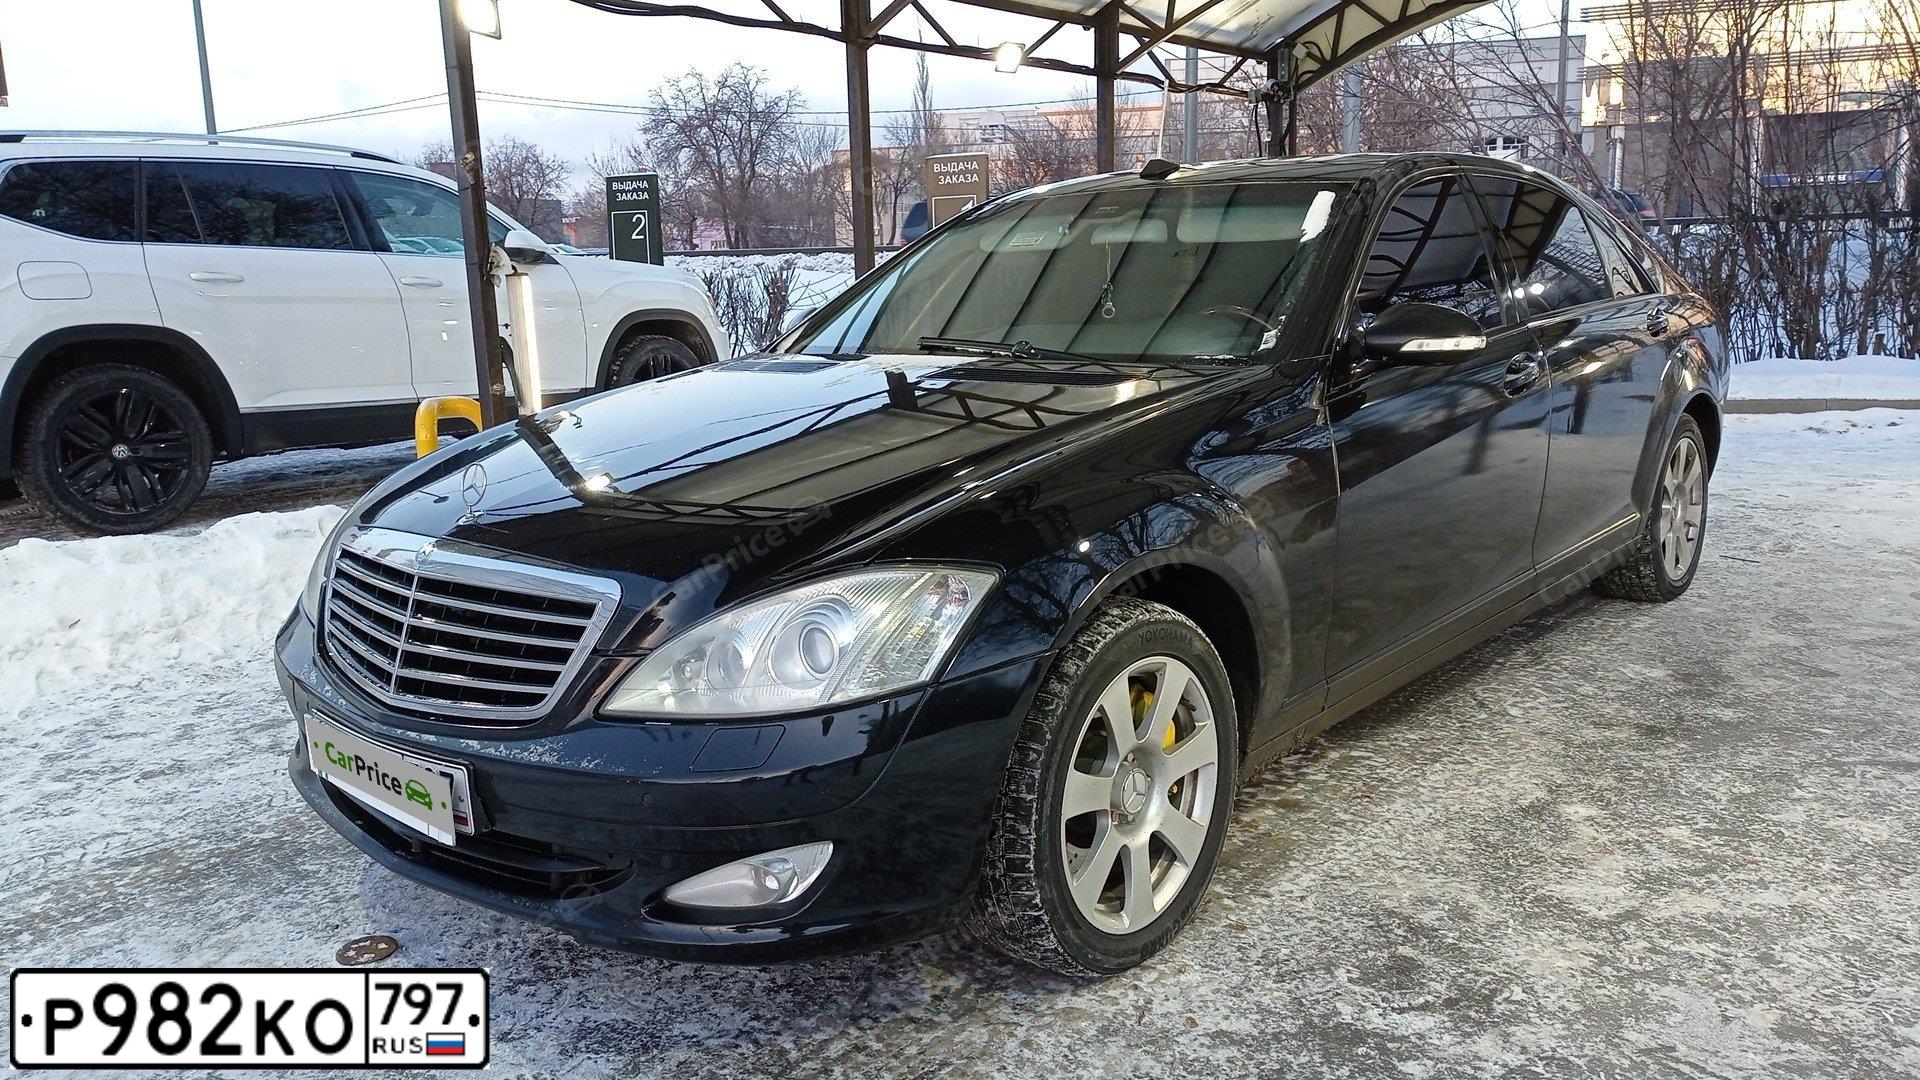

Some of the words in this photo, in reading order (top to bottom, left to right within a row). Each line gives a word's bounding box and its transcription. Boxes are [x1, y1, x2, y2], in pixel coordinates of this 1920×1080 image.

[933, 160, 979, 173] ВЫДАЧА
[938, 173, 980, 185] ЗАКАЗА
[612, 180, 649, 191] ВЫДАЧА
[616, 191, 650, 201] ЗАКАЗА
[631, 213, 646, 240] 2
